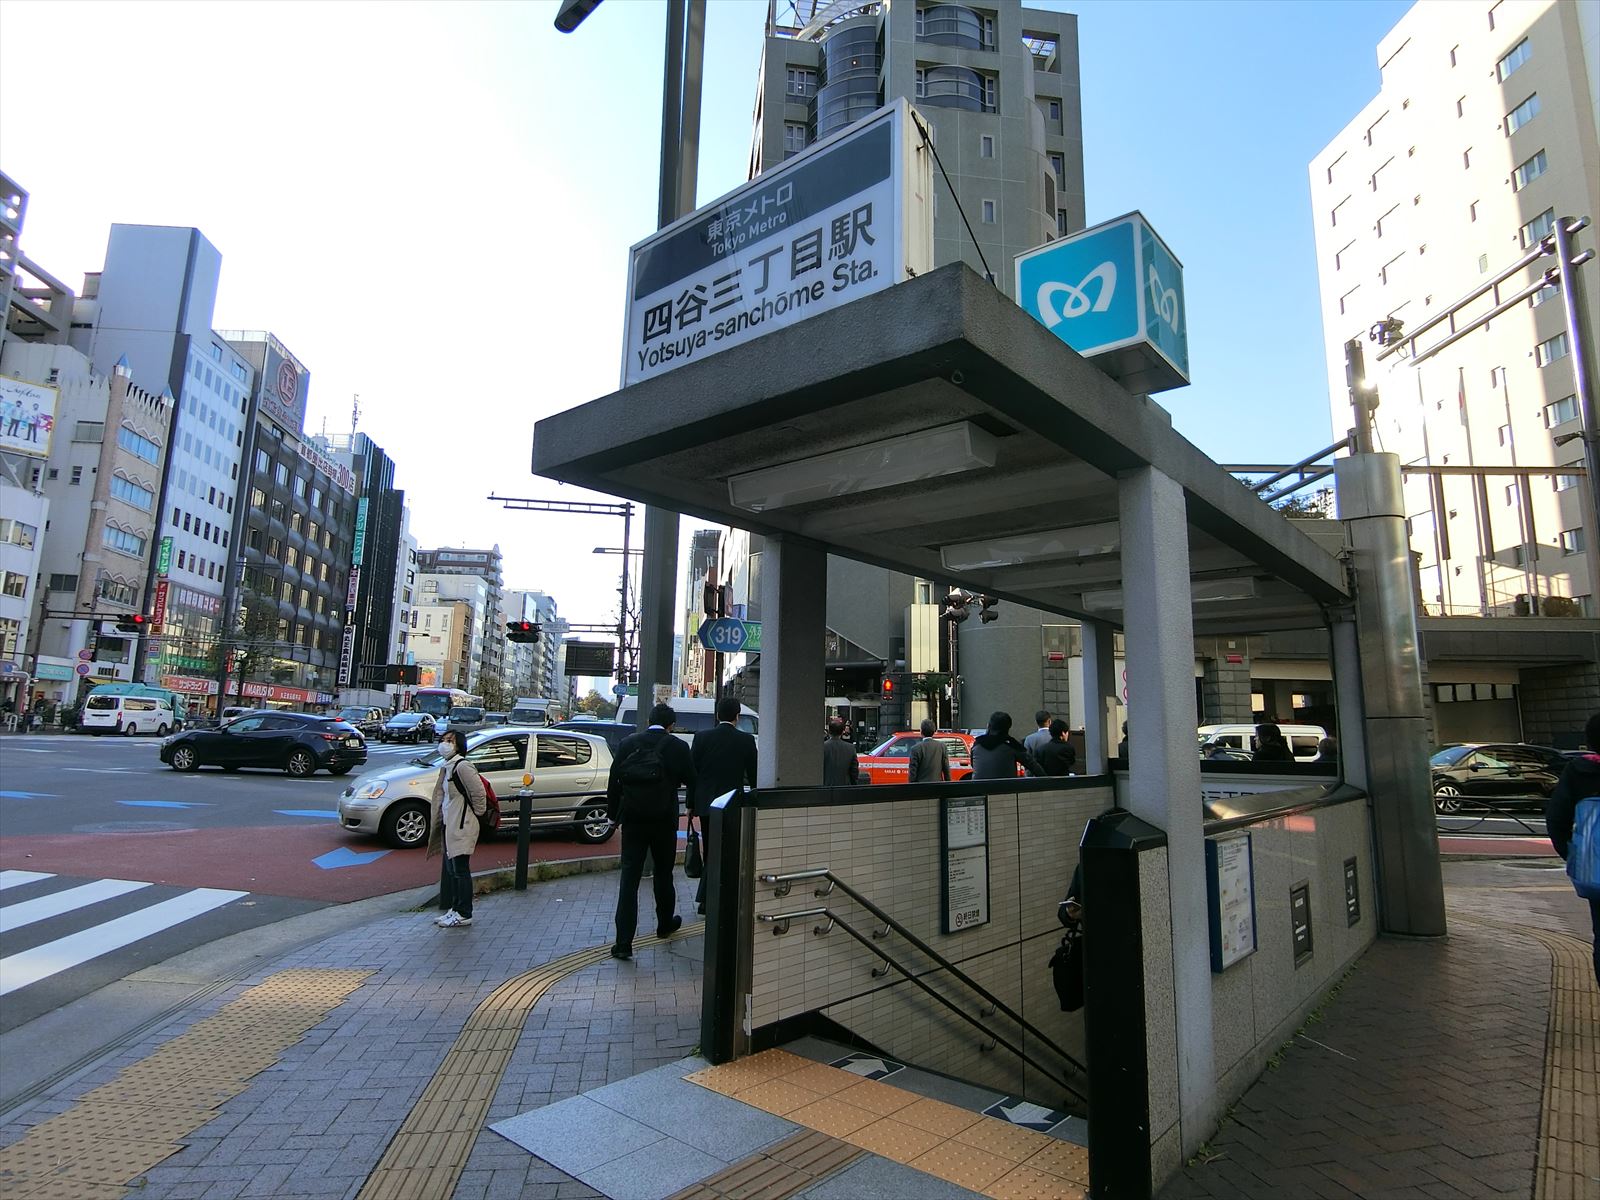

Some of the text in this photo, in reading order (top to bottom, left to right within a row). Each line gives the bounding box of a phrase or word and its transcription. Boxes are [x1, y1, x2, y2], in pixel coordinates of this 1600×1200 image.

[706, 181, 794, 245] 東京メトロ
[711, 211, 787, 257] Tokyo Metro
[642, 202, 877, 345] 四谷三丁目駅
[637, 257, 879, 372] Yotsuya-sanchōme Sta.
[715, 626, 742, 645] 319
